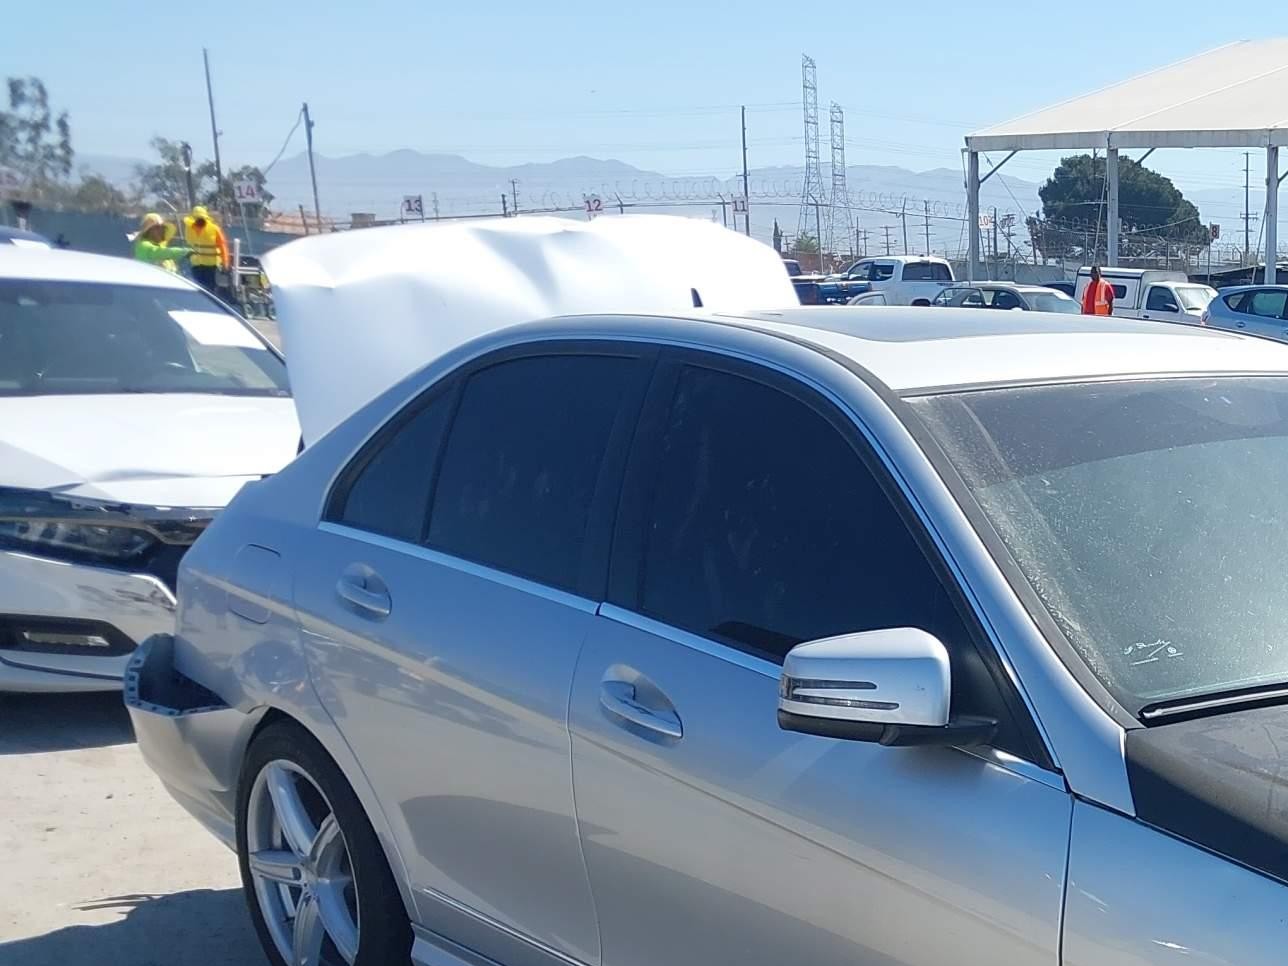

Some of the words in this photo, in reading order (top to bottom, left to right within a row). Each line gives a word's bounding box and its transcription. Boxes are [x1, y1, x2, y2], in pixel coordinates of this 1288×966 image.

[238, 185, 255, 199] 14
[405, 199, 422, 213] 13
[585, 199, 602, 212] 12
[733, 200, 746, 212] 11
[1211, 225, 1218, 238] 8
